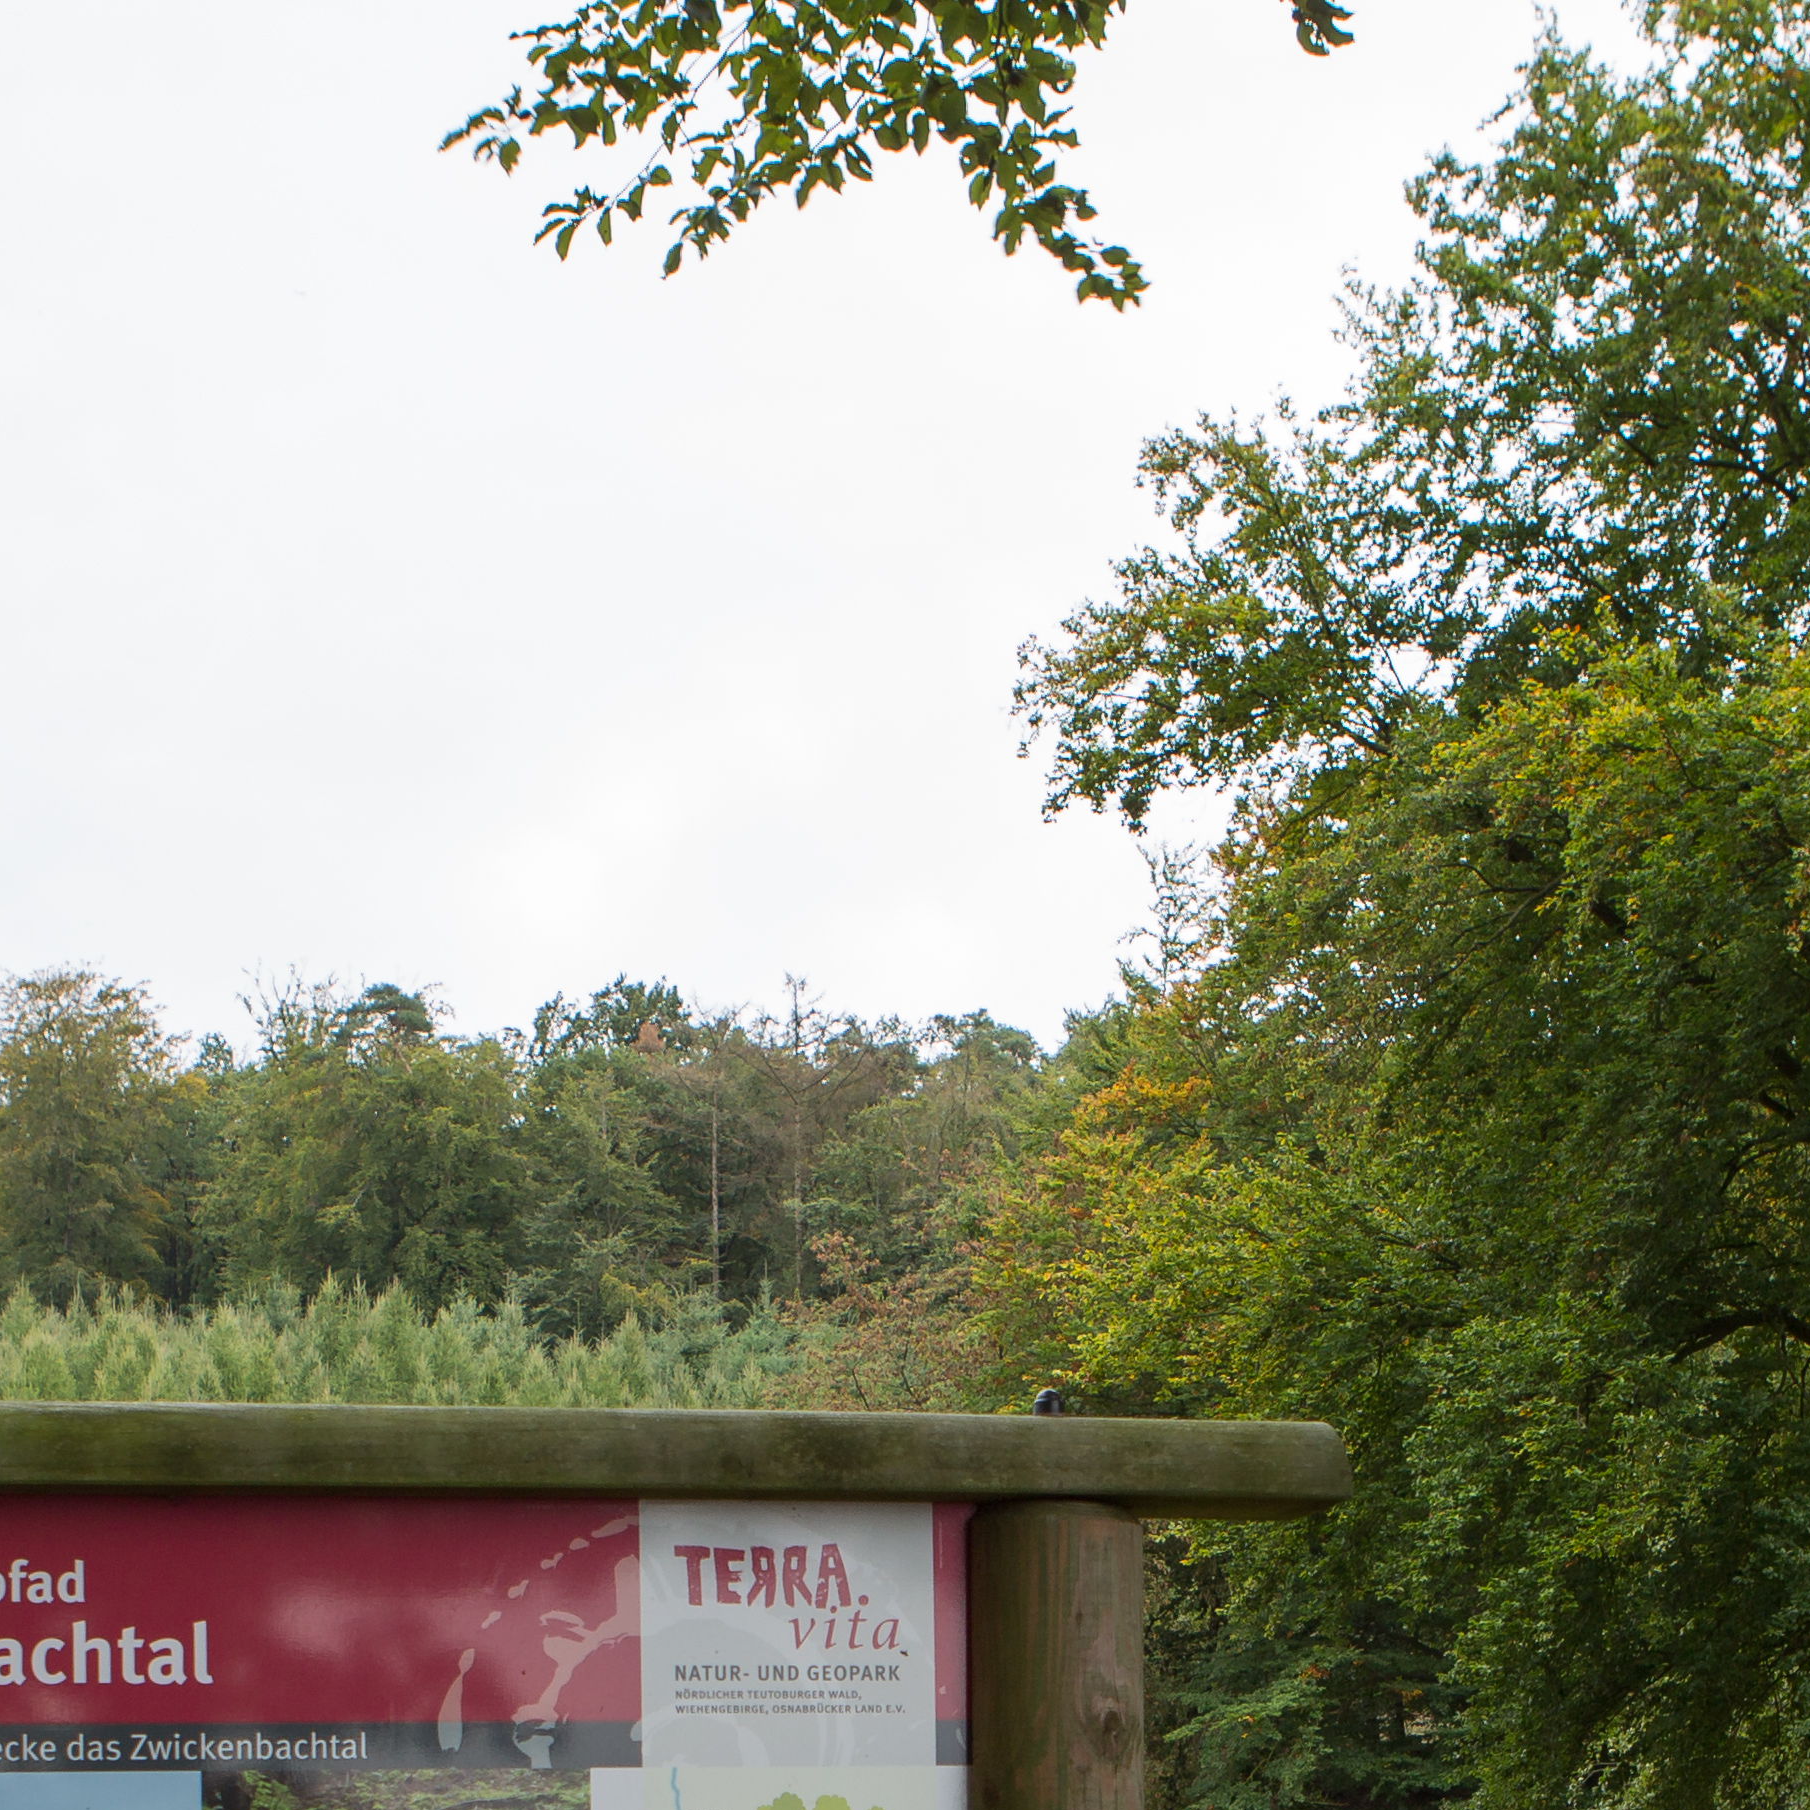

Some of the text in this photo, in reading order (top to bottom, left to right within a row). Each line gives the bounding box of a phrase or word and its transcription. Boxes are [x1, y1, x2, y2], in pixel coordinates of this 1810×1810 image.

[789, 1605, 900, 1650] vita
[675, 1665, 900, 1682] NATUR- UND GEOPARK
[676, 1688, 862, 1700] NÖRDLICHER TEUTOBURGER WALD,
[676, 1703, 905, 1715] WIEHENGEBIRGE, OSNABRÜCKER LAND E.V.
[67, 1732, 120, 1762] das
[130, 1731, 368, 1761] Zwickenbachtal
